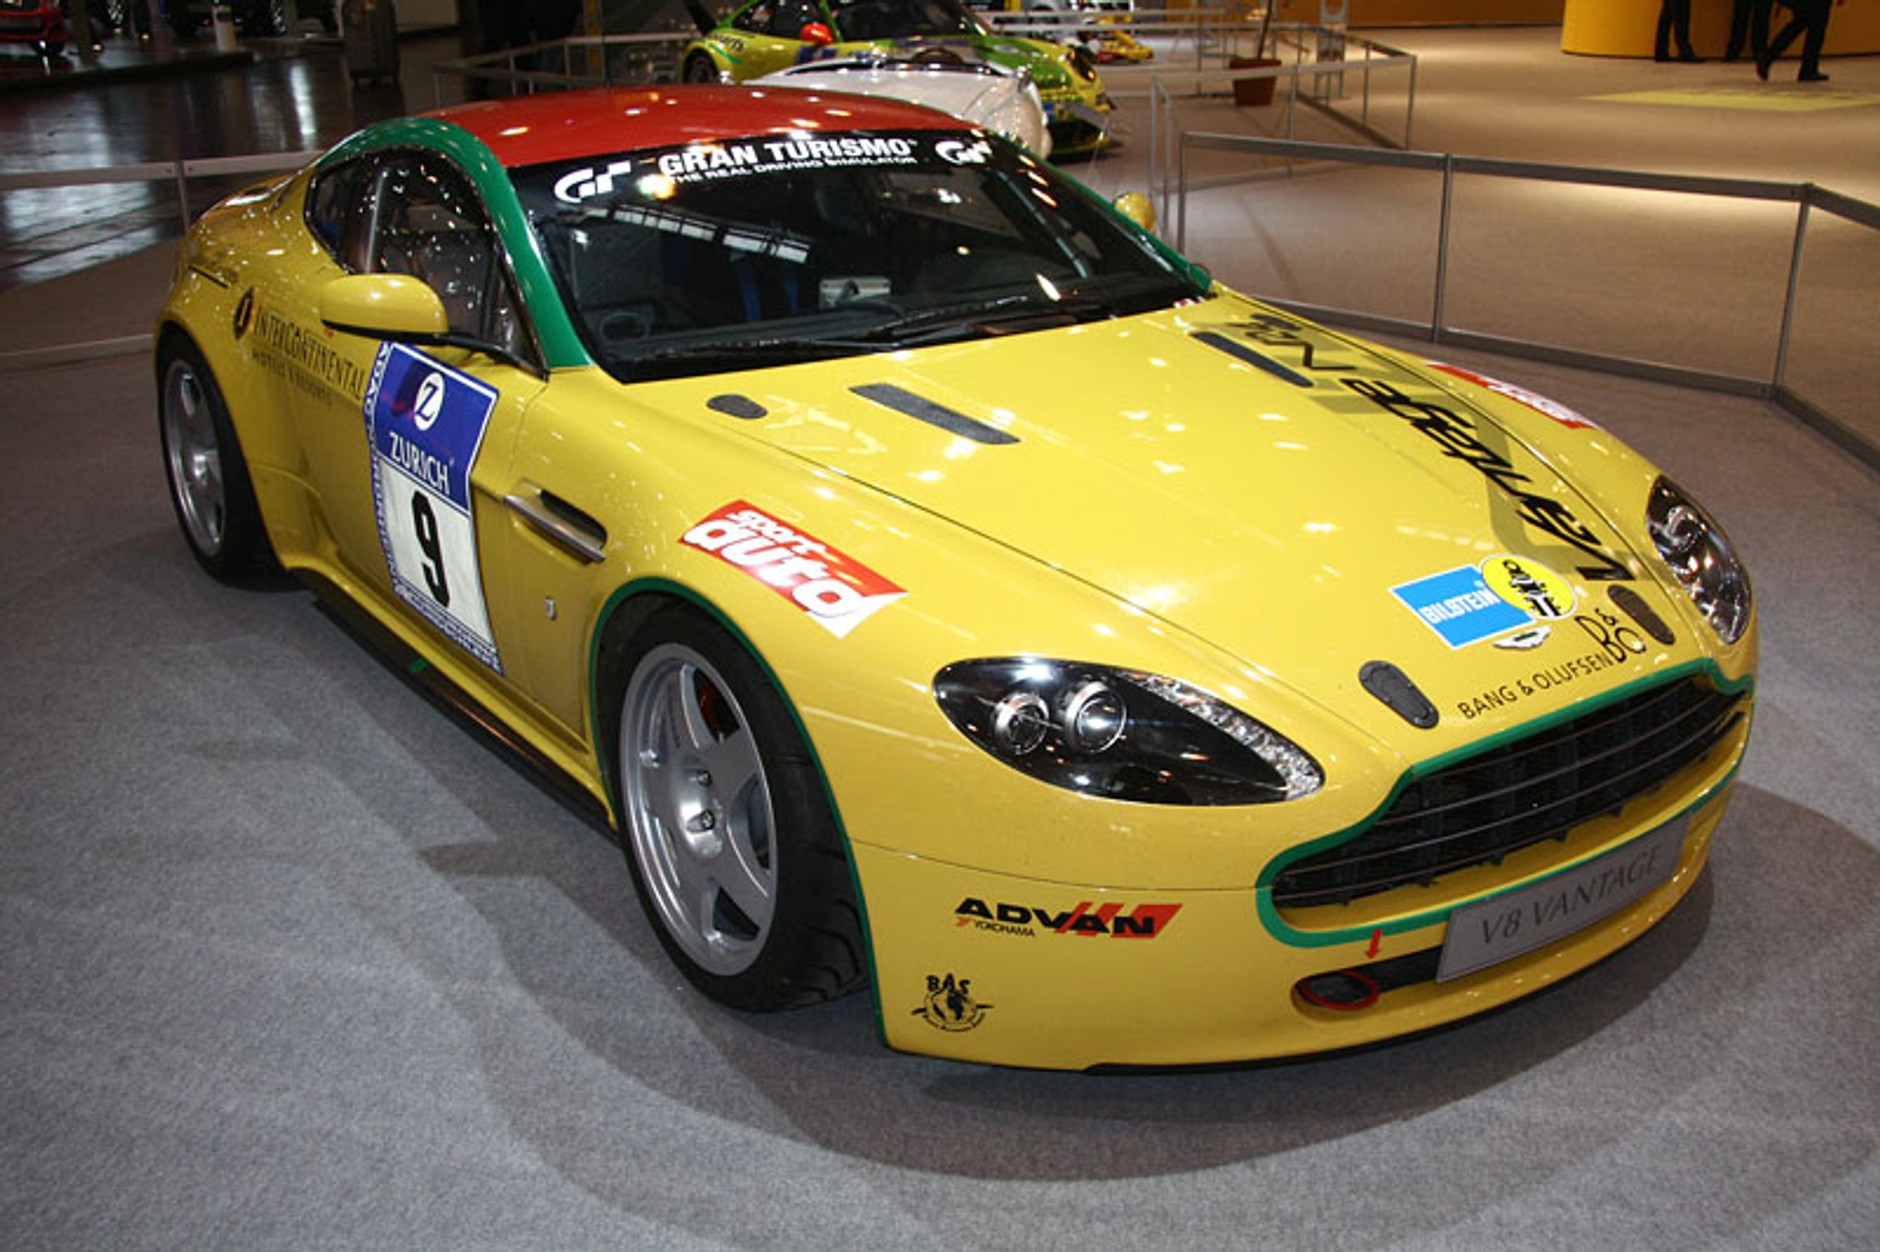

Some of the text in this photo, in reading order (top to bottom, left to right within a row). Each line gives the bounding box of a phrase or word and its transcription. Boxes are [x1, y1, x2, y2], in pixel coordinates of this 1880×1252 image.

[658, 137, 912, 178] GRAN TURISMO
[704, 166, 753, 179] REAL
[753, 160, 824, 174] DRIVING
[824, 156, 918, 167] SIMULATOR
[254, 305, 365, 402] INTERCONTINENTAL
[389, 431, 451, 495] ZURICH
[411, 489, 450, 609] 9
[725, 509, 827, 554] sport
[682, 518, 864, 619] auto
[1418, 588, 1501, 625] BILSTEIN
[1457, 652, 1614, 719] BANG & OLUFSEN
[955, 897, 1155, 934] ADVAN
[1480, 843, 1662, 945] V8 VANTAGE
[973, 919, 1036, 937] YOKOHAMA
